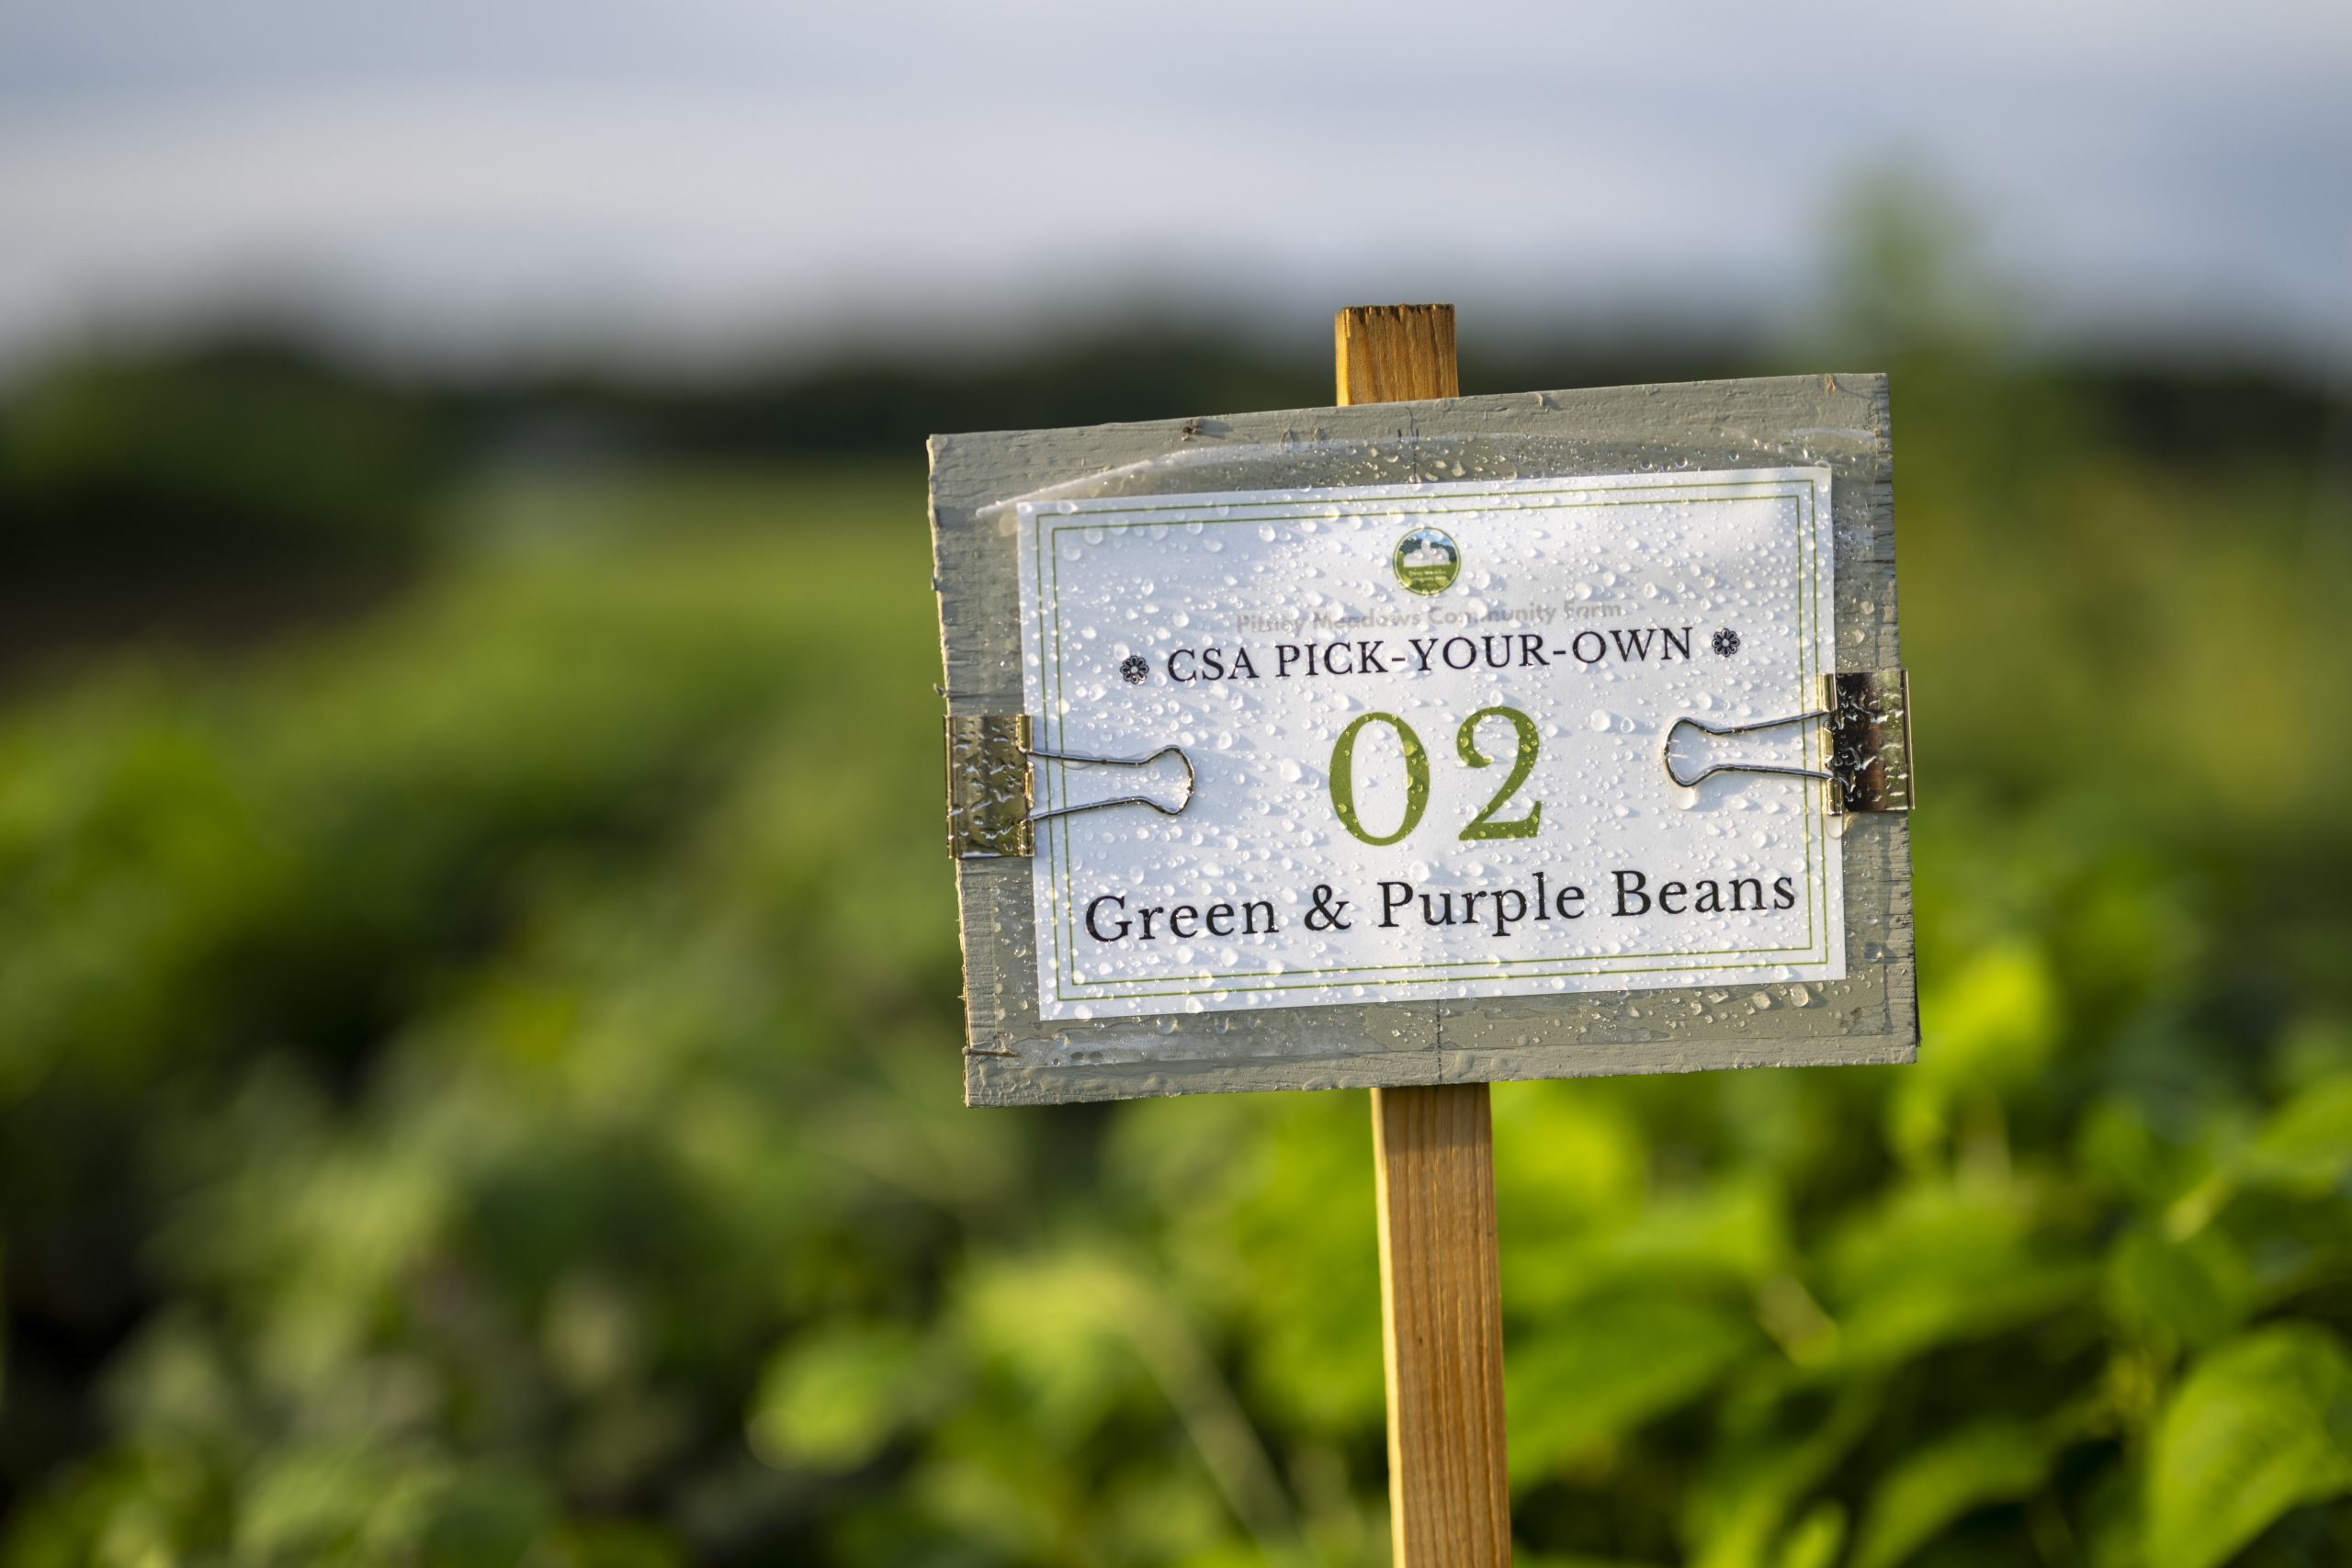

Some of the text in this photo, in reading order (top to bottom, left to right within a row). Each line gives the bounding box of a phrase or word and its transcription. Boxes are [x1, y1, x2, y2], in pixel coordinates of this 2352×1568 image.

[1312, 608, 1421, 629] Meadows
[1564, 600, 1623, 620] Farm
[1167, 626, 1693, 682] CSA PICK-YOUR-OWN
[1329, 705, 1543, 847] 02
[1085, 869, 1796, 942] Green & Purple Beans
